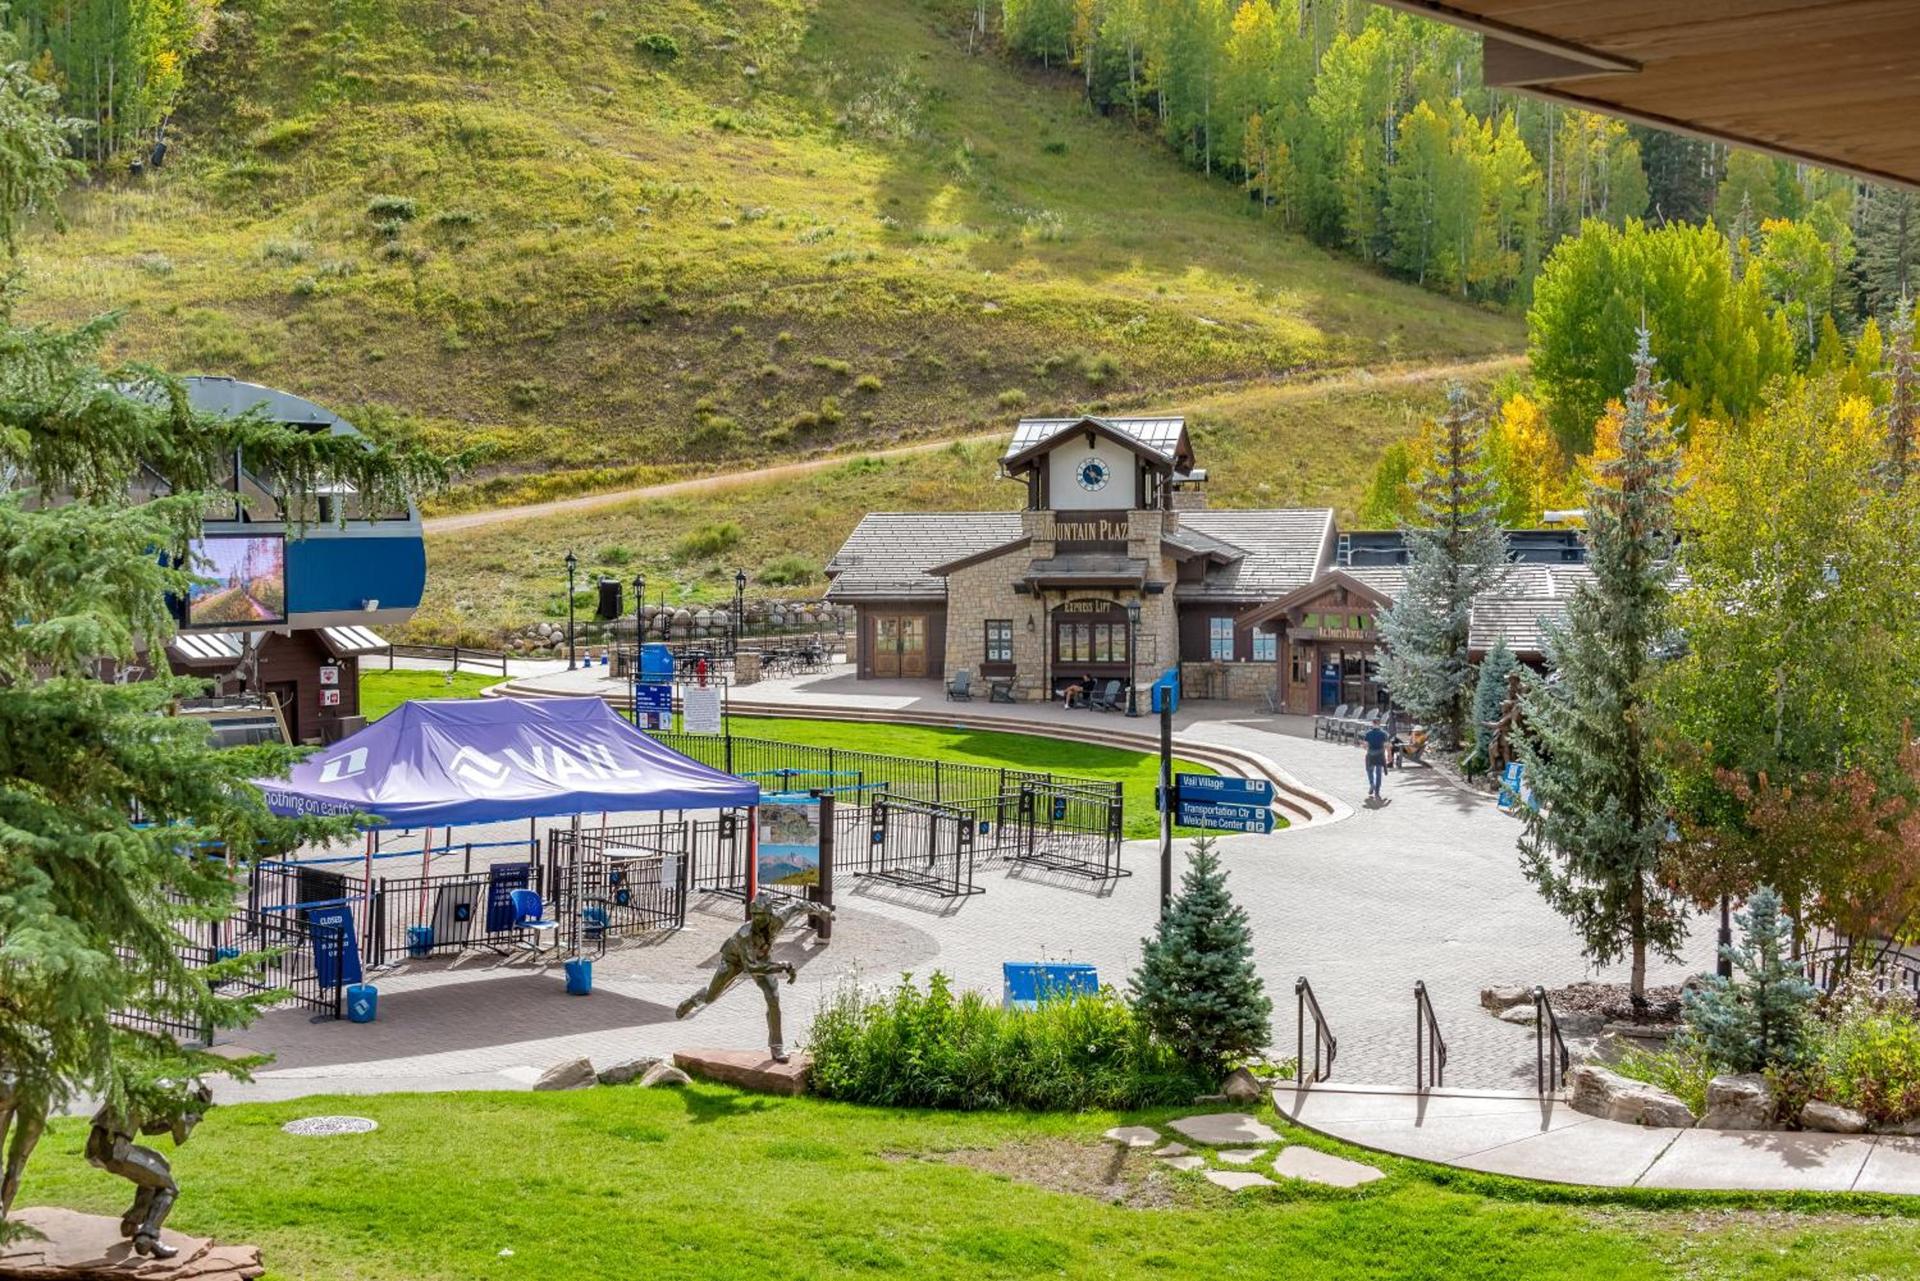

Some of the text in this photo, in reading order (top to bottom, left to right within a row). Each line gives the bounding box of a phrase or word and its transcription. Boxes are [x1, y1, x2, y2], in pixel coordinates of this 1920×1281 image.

[1100, 519, 1128, 541] PLAZ
[503, 744, 641, 779] VAIL
[1183, 776, 1224, 790] Vail Village
[264, 790, 304, 815] nothing
[305, 799, 320, 813] on
[1184, 803, 1249, 817] Transportation Ctr
[1219, 819, 1244, 829] Center
[320, 916, 342, 925] CLOSED
